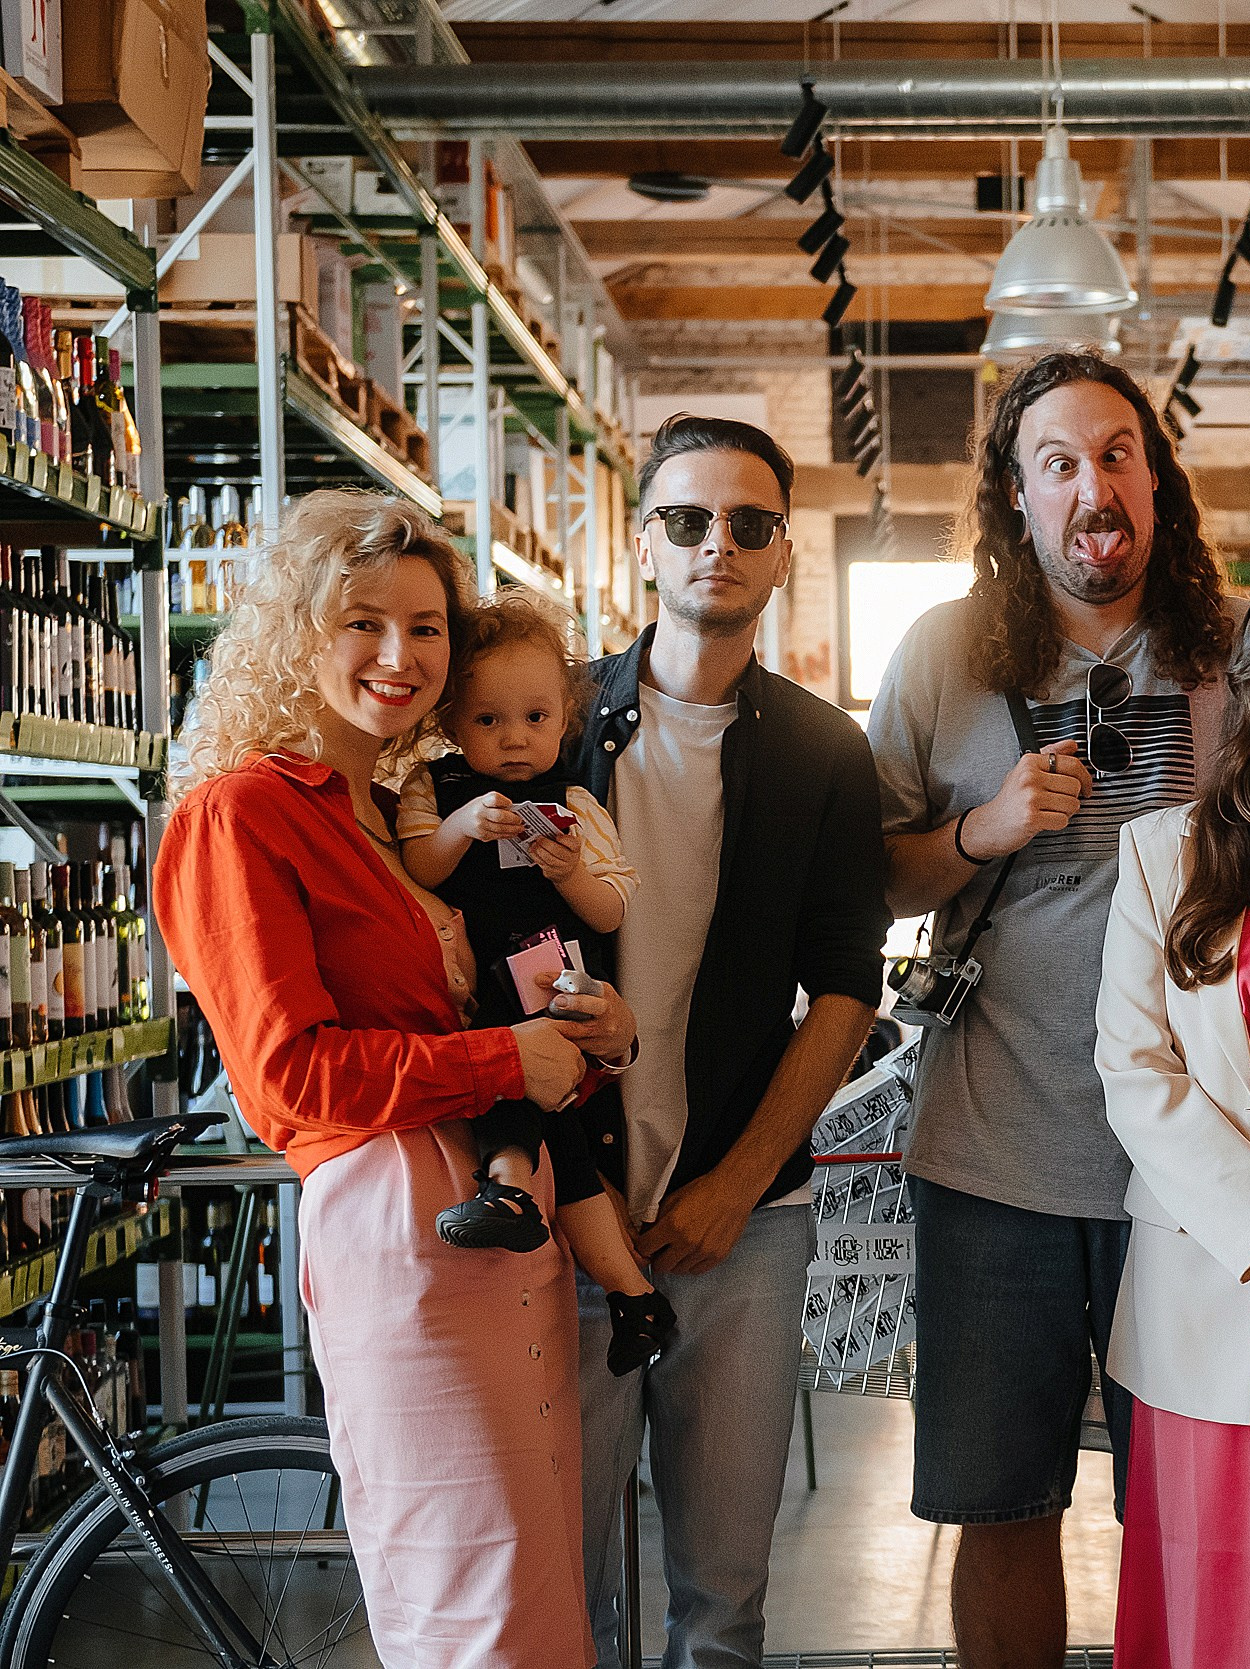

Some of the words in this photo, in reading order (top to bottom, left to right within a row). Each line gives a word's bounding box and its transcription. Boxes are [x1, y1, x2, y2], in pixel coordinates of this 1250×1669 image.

[102, 1470, 123, 1495] BORN
[121, 1497, 132, 1509] IN
[130, 1510, 145, 1528] THE
[143, 1529, 173, 1570] STREETS
